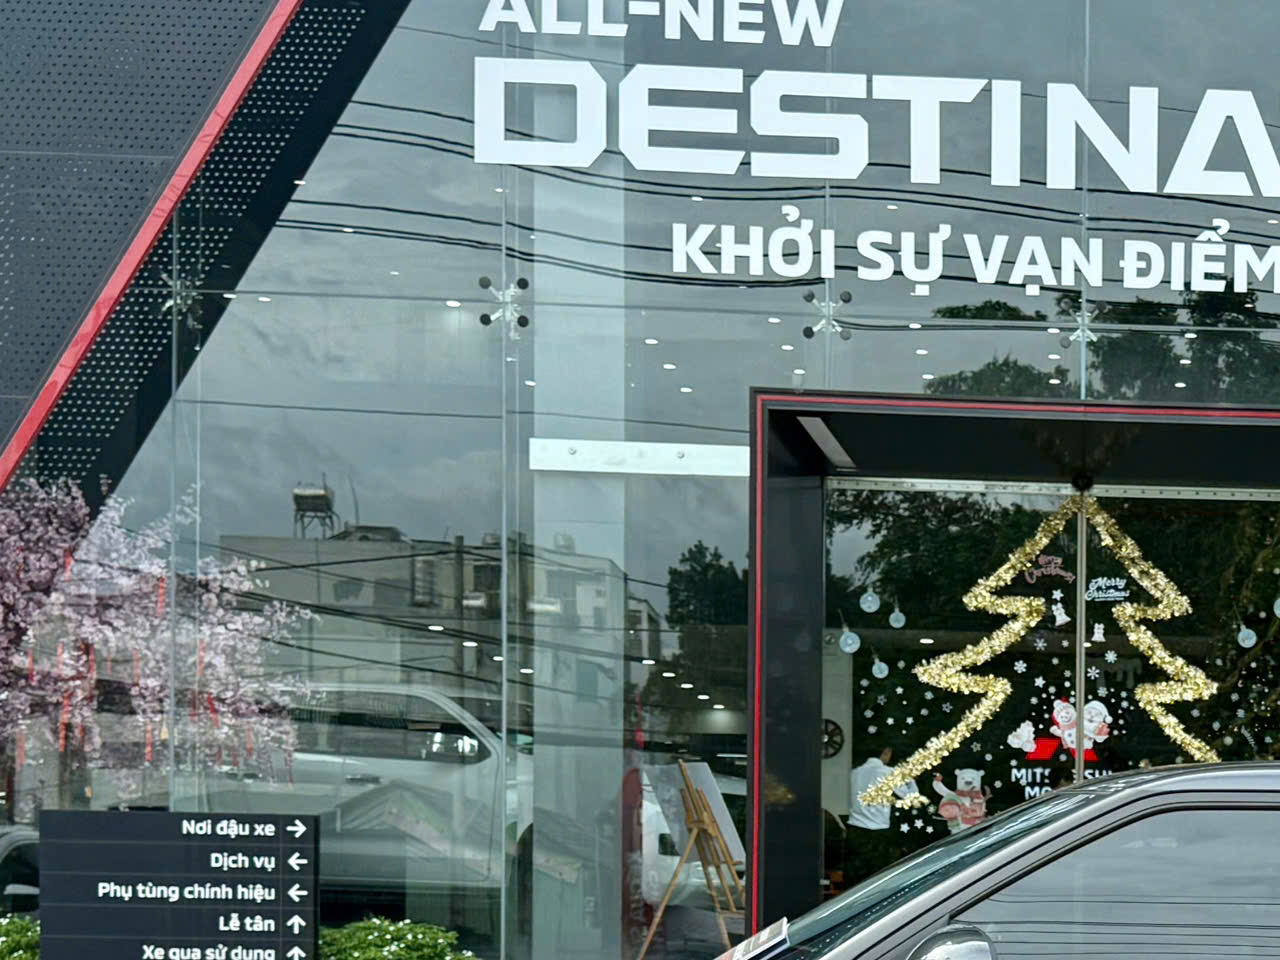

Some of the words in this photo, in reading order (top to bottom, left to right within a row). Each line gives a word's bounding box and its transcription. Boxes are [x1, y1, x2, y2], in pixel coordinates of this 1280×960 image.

[478, 0, 844, 47] ALL-NEW
[671, 205, 835, 278] KHỞI
[857, 223, 951, 296] SỰ
[964, 233, 1103, 296] VẠN
[1089, 576, 1127, 590] Merry
[182, 819, 212, 835] Nơi
[216, 819, 250, 839] đậu
[253, 823, 276, 836] xe
[210, 852, 249, 871] Dịch
[252, 856, 276, 872] vụ
[98, 882, 133, 901] Phụ
[136, 882, 180, 902] tùng
[183, 883, 233, 900] chính
[237, 884, 276, 903] hiệu
[218, 912, 241, 931] Lễ
[244, 915, 275, 932] tân
[142, 944, 166, 960] Xe
[205, 943, 228, 960] sử
